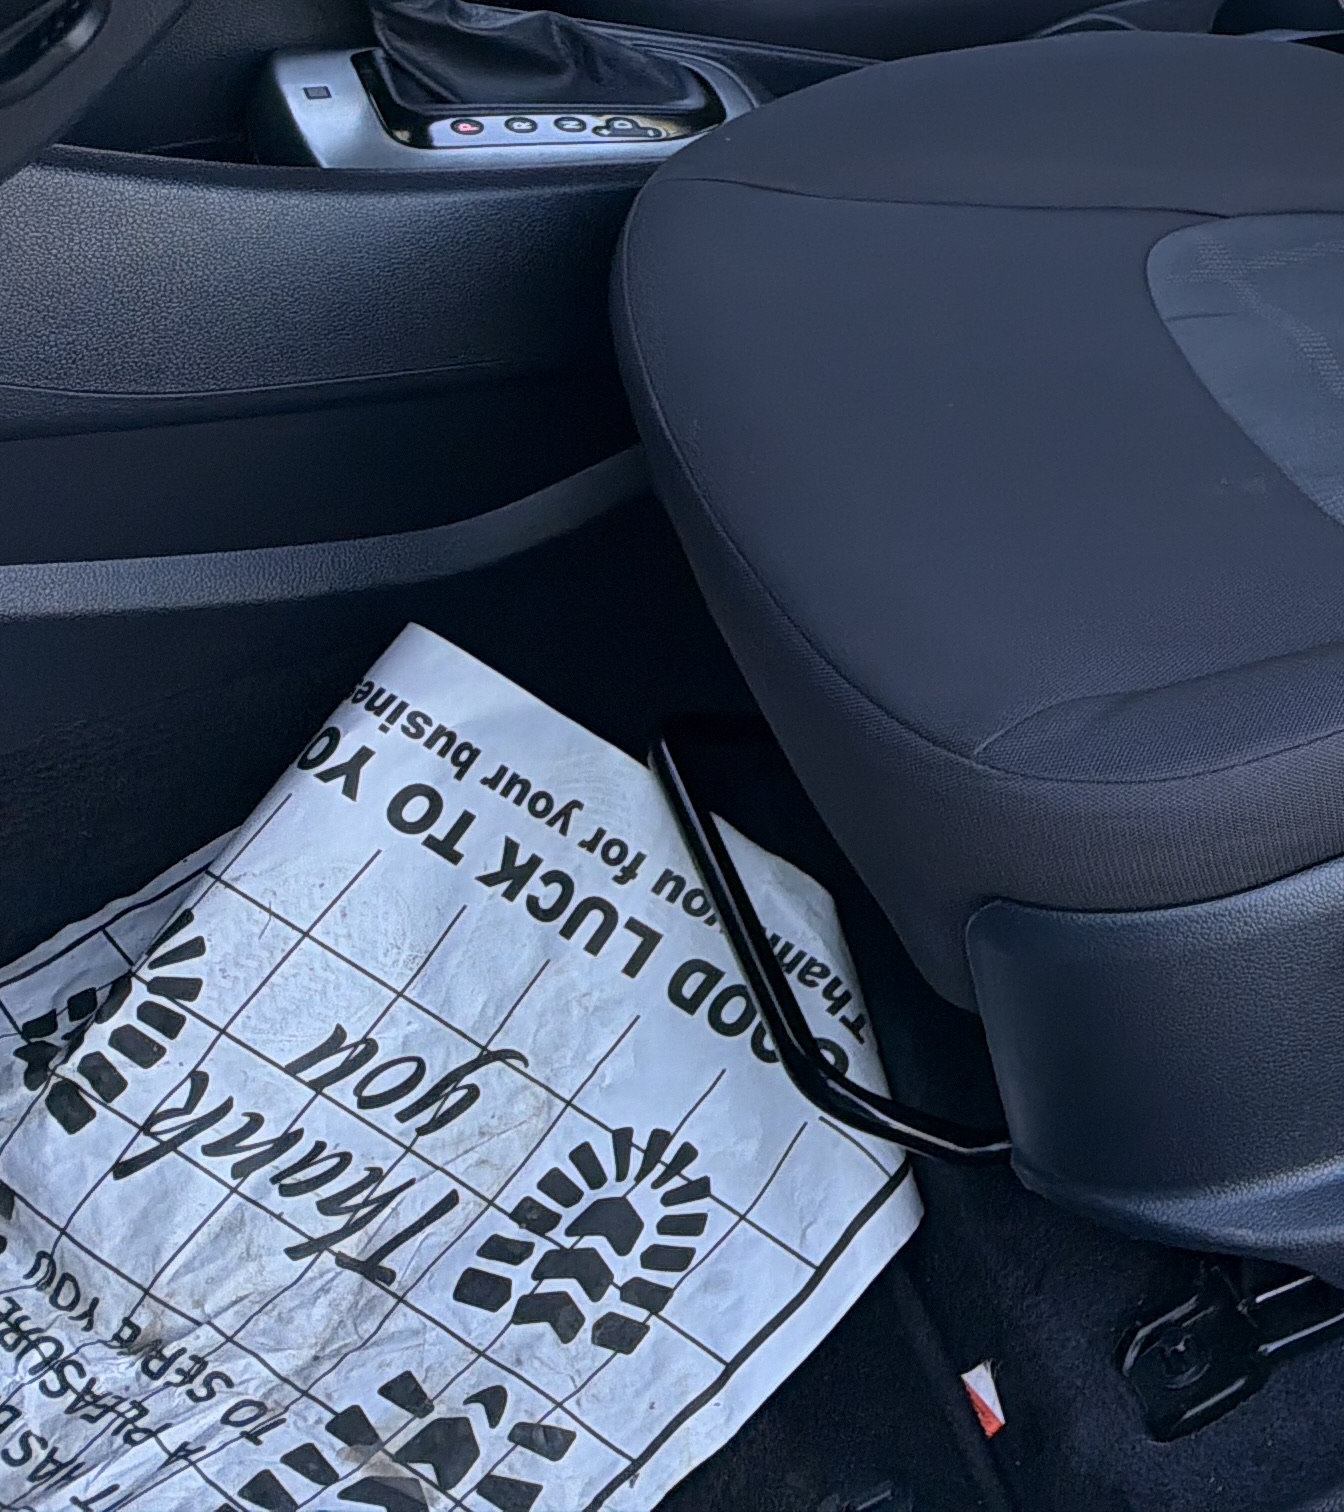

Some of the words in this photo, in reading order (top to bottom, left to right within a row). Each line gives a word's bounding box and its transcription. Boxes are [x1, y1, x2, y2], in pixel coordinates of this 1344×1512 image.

[457, 123, 480, 133] P
[512, 121, 533, 130] R
[562, 120, 581, 130] N
[347, 674, 481, 780] busine
[379, 774, 482, 863] TO
[478, 760, 583, 833] your
[580, 823, 645, 884] for
[648, 866, 713, 926] ou
[474, 835, 663, 976] LUCK
[762, 926, 864, 1045] Than
[284, 1021, 526, 1147] you
[109, 1066, 460, 1282] Thank
[21, 1251, 100, 1334] YOU
[110, 1315, 231, 1404] SERE
[222, 1400, 287, 1446] TO
